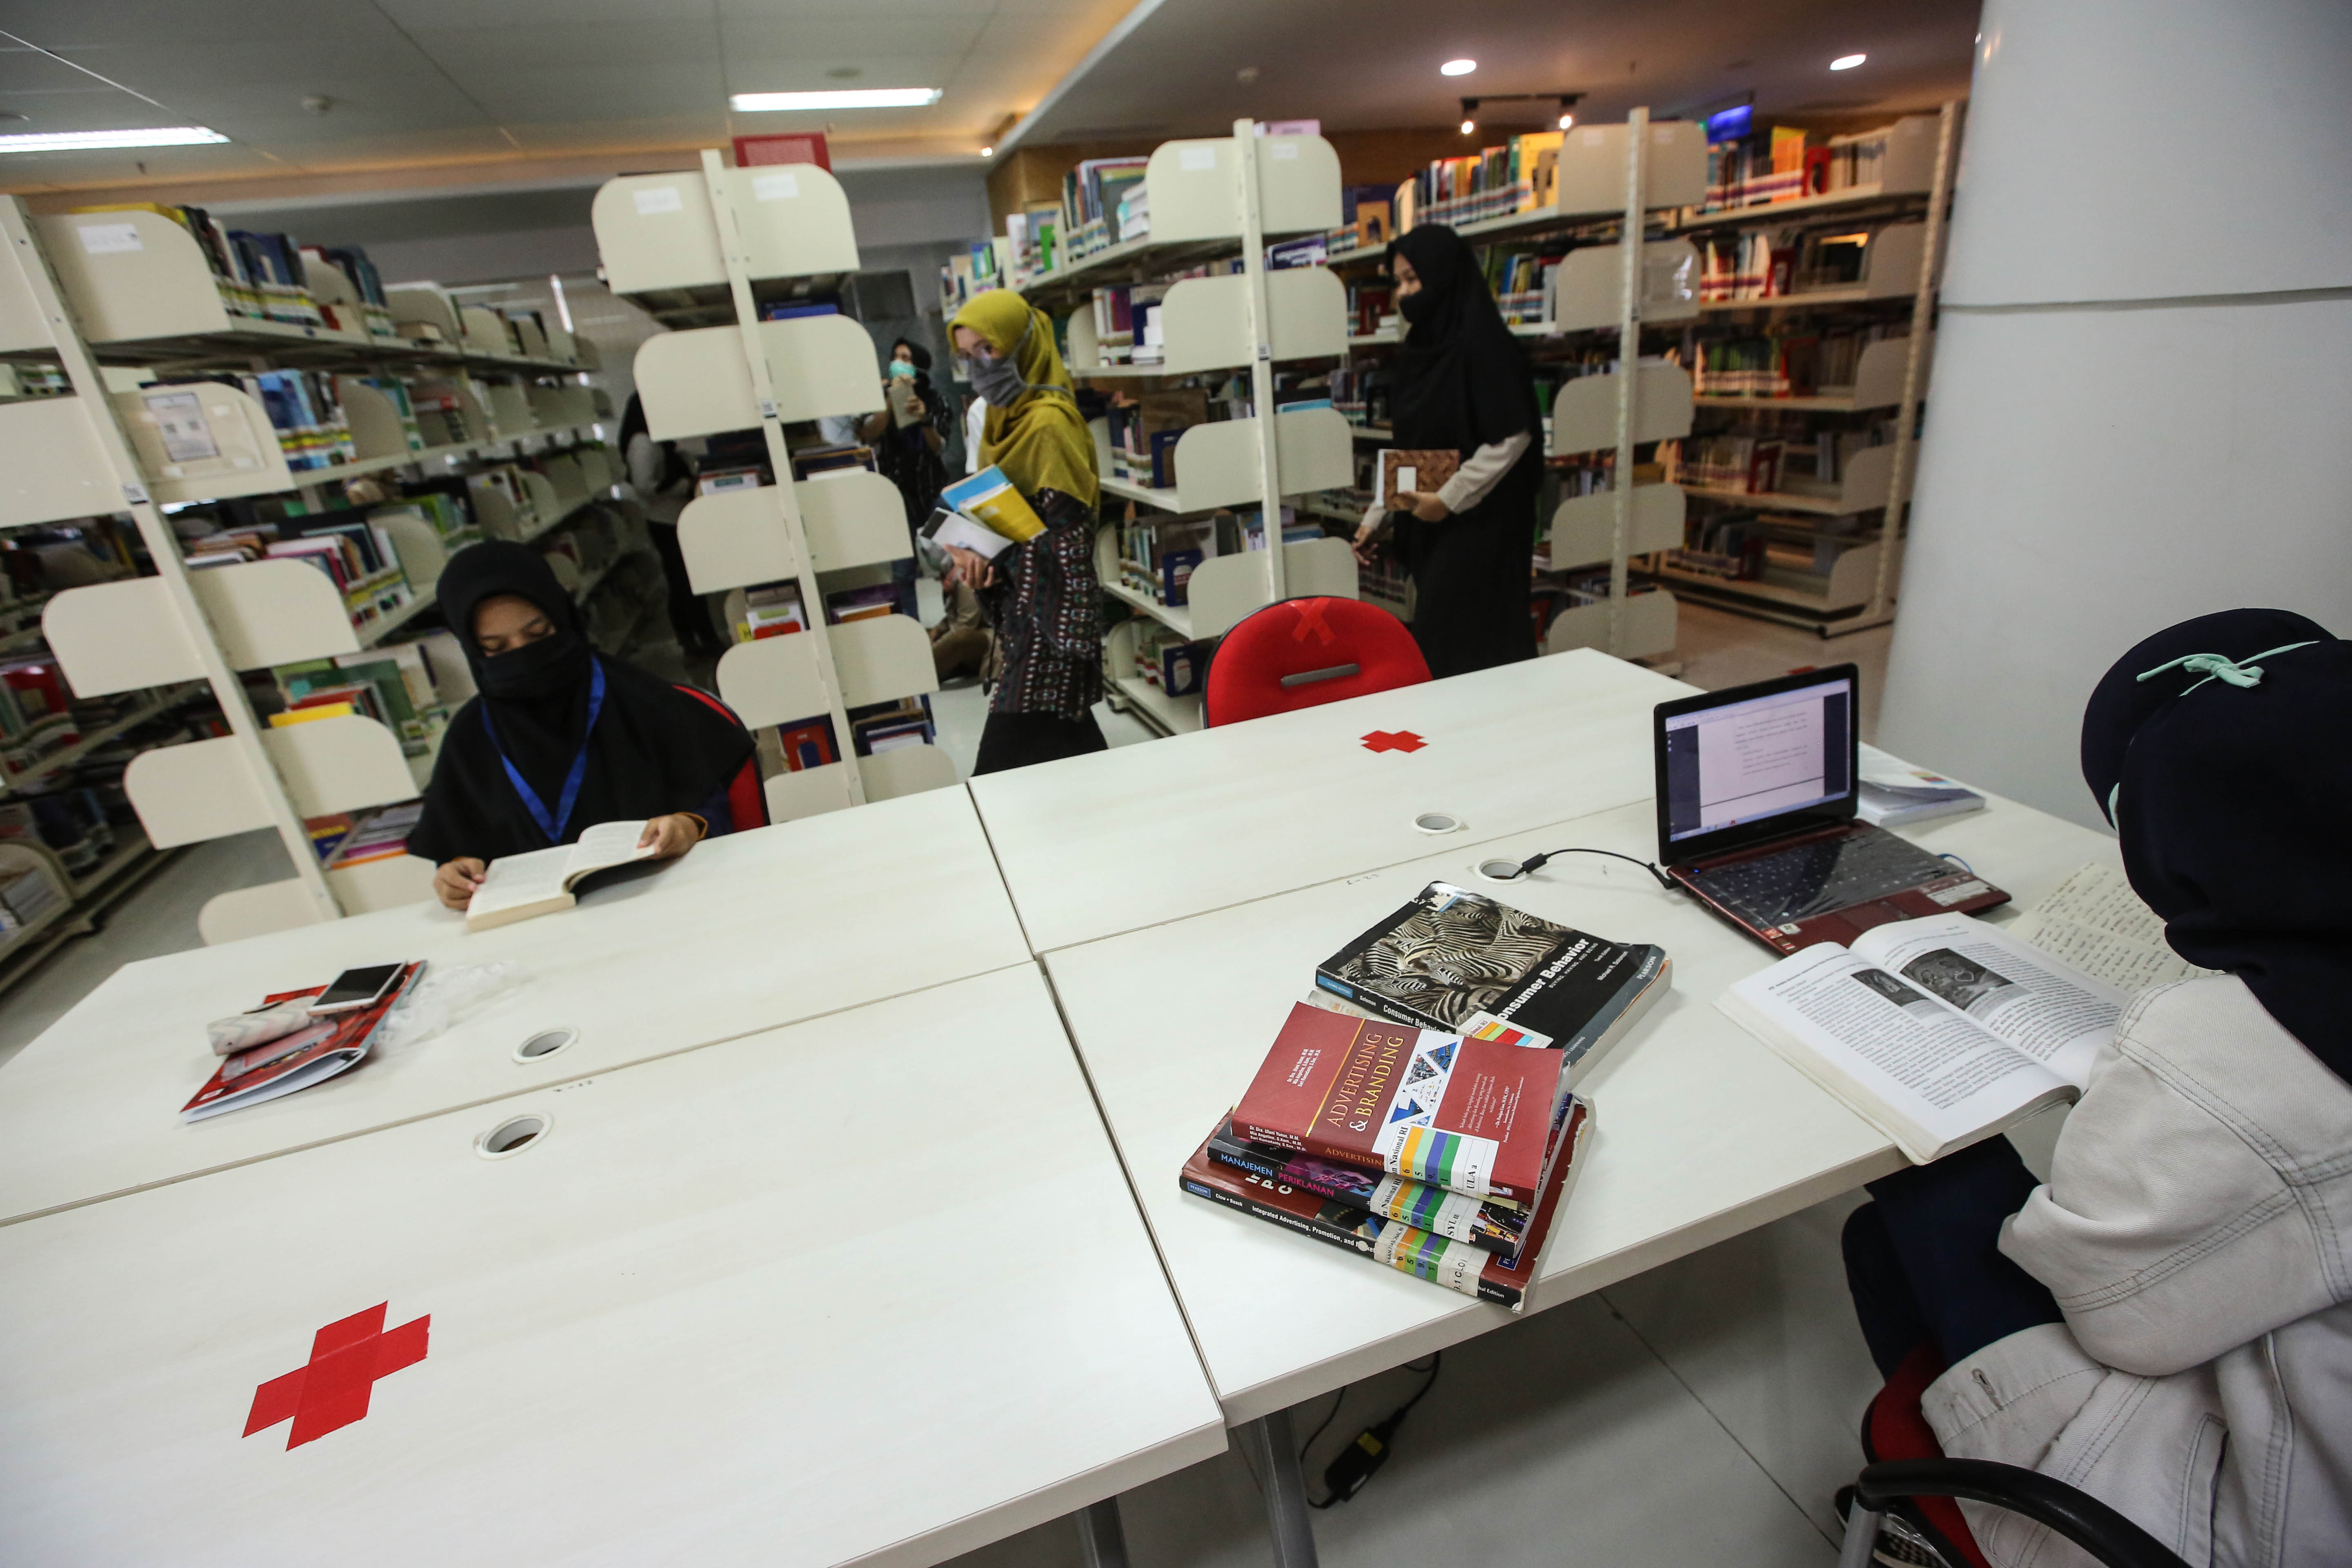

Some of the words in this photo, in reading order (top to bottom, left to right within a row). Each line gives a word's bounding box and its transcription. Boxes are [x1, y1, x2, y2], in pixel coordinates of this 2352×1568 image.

[1548, 975, 1566, 988] BUYING,
[1564, 961, 1581, 975] HAVING,
[1586, 942, 1598, 953] BEING
[1636, 956, 1657, 980] PEARSON
[1497, 978, 1546, 1020] onsumer
[1540, 938, 1589, 979] Behavior
[1359, 995, 1376, 1007] Solomon
[1383, 1004, 1414, 1024] Consumer
[1415, 1018, 1443, 1032] Behavi
[1568, 1036, 1585, 1053] LEARNING
[1327, 1033, 1383, 1128] ADVERTISING
[1354, 1036, 1404, 1117] BRANDING
[1349, 1120, 1369, 1132] &
[1325, 1147, 1383, 1166] ADVERTISIN
[1390, 1136, 1405, 1166] Nasional
[1399, 1127, 1408, 1135] RI
[1221, 1153, 1273, 1177] MANAJEMEN
[1278, 1172, 1334, 1197] PERIKLANAN
[1467, 1171, 1476, 1189] ULA
[1190, 1185, 1208, 1194] PEARSON
[1229, 1198, 1243, 1207] Baack
[1252, 1205, 1278, 1219] Integrated
[1279, 1215, 1311, 1232] Advertising,
[1312, 1226, 1343, 1242] Promotion,
[1344, 1238, 1354, 1246] and
[1447, 1220, 1457, 1236] SYL
[1455, 1262, 1465, 1278] CLO
[1487, 1288, 1504, 1298] Edition
